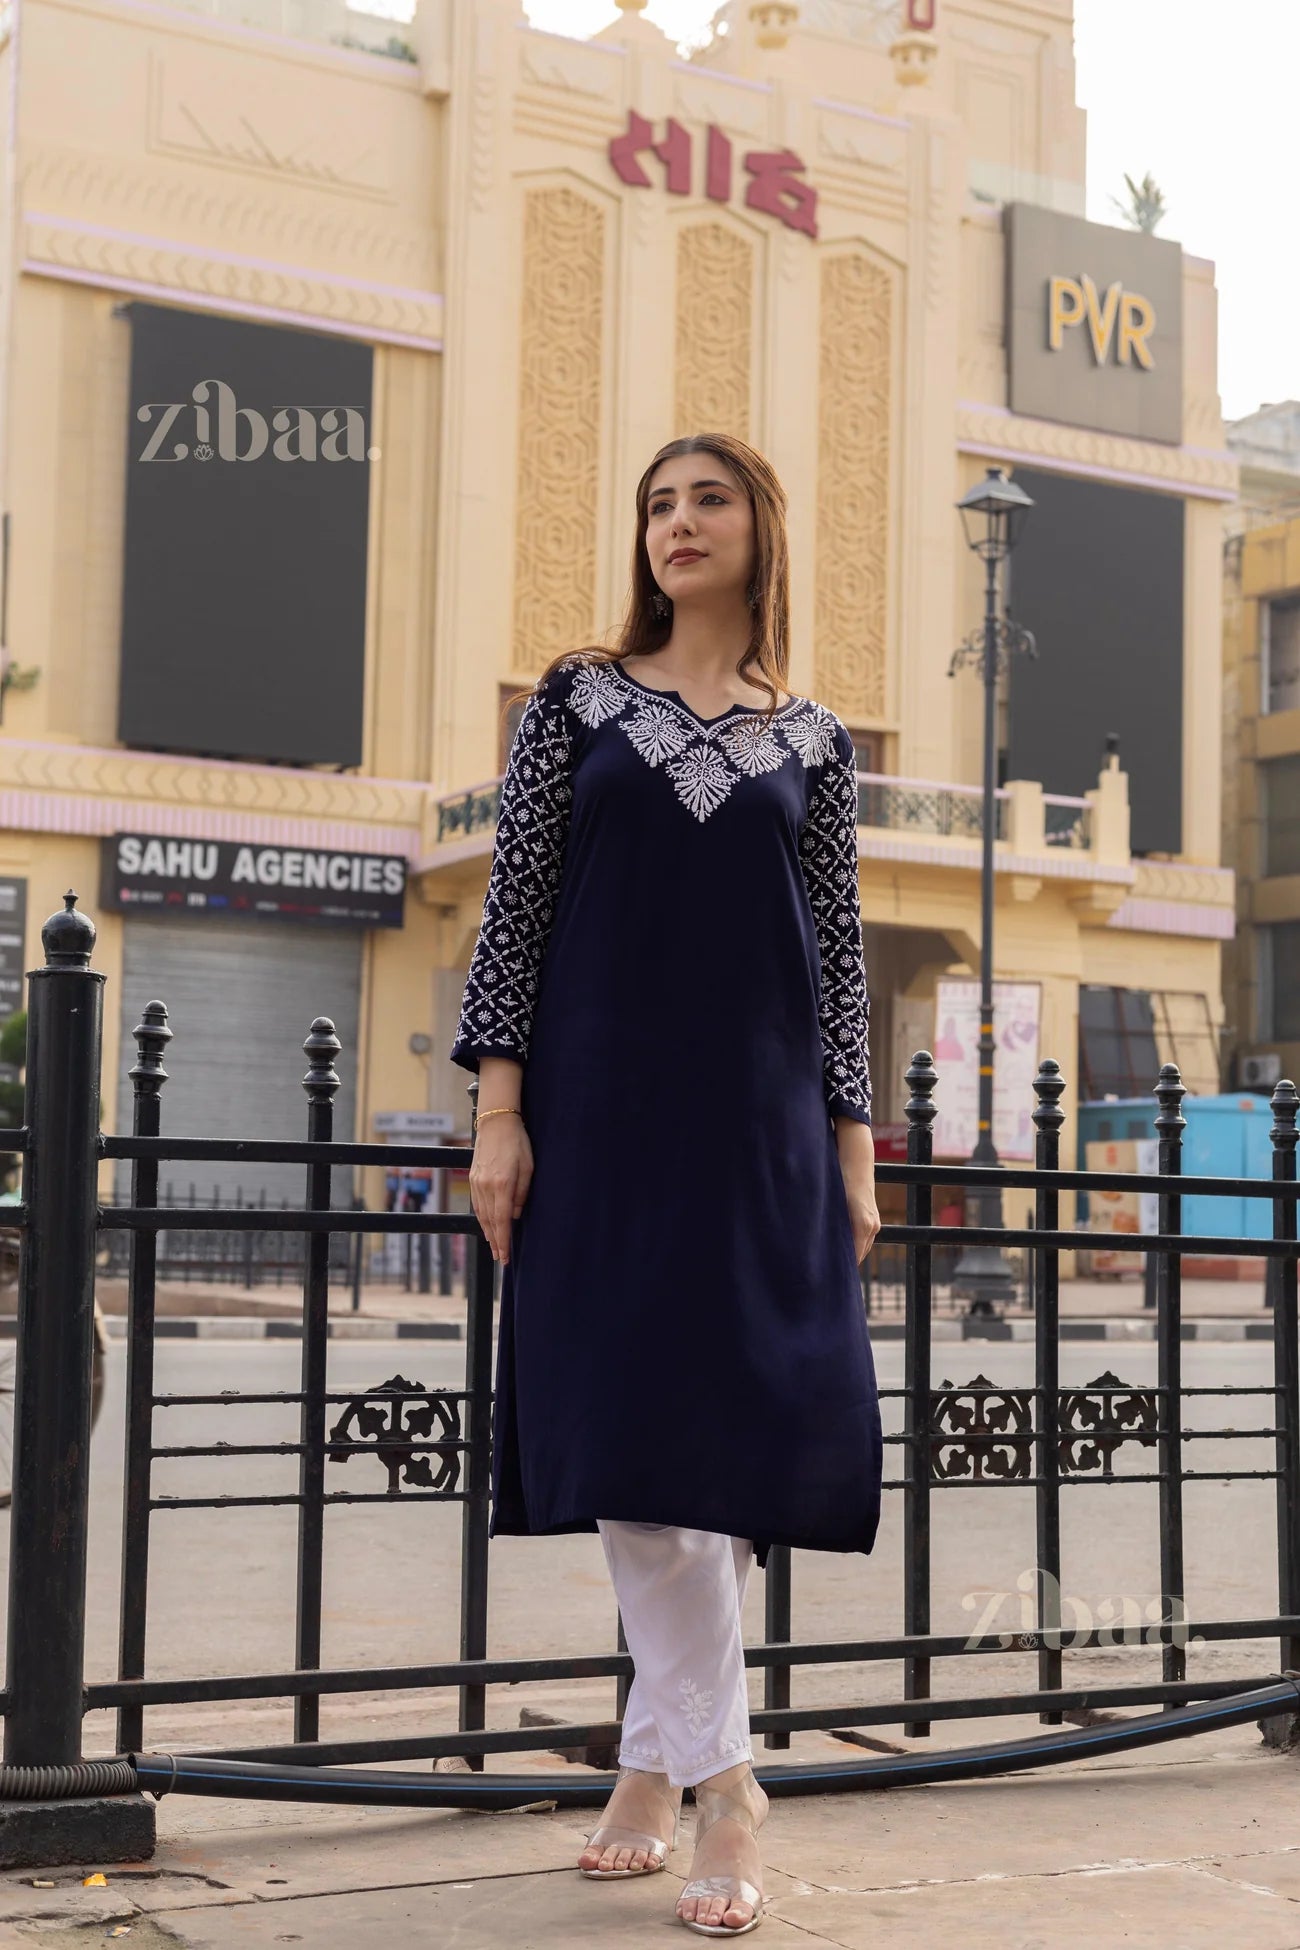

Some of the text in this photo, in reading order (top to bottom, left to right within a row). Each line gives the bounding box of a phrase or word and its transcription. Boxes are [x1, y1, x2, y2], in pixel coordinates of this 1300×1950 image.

[1047, 273, 1156, 367] PVR
[118, 838, 405, 894] SAHU AGENCIES
